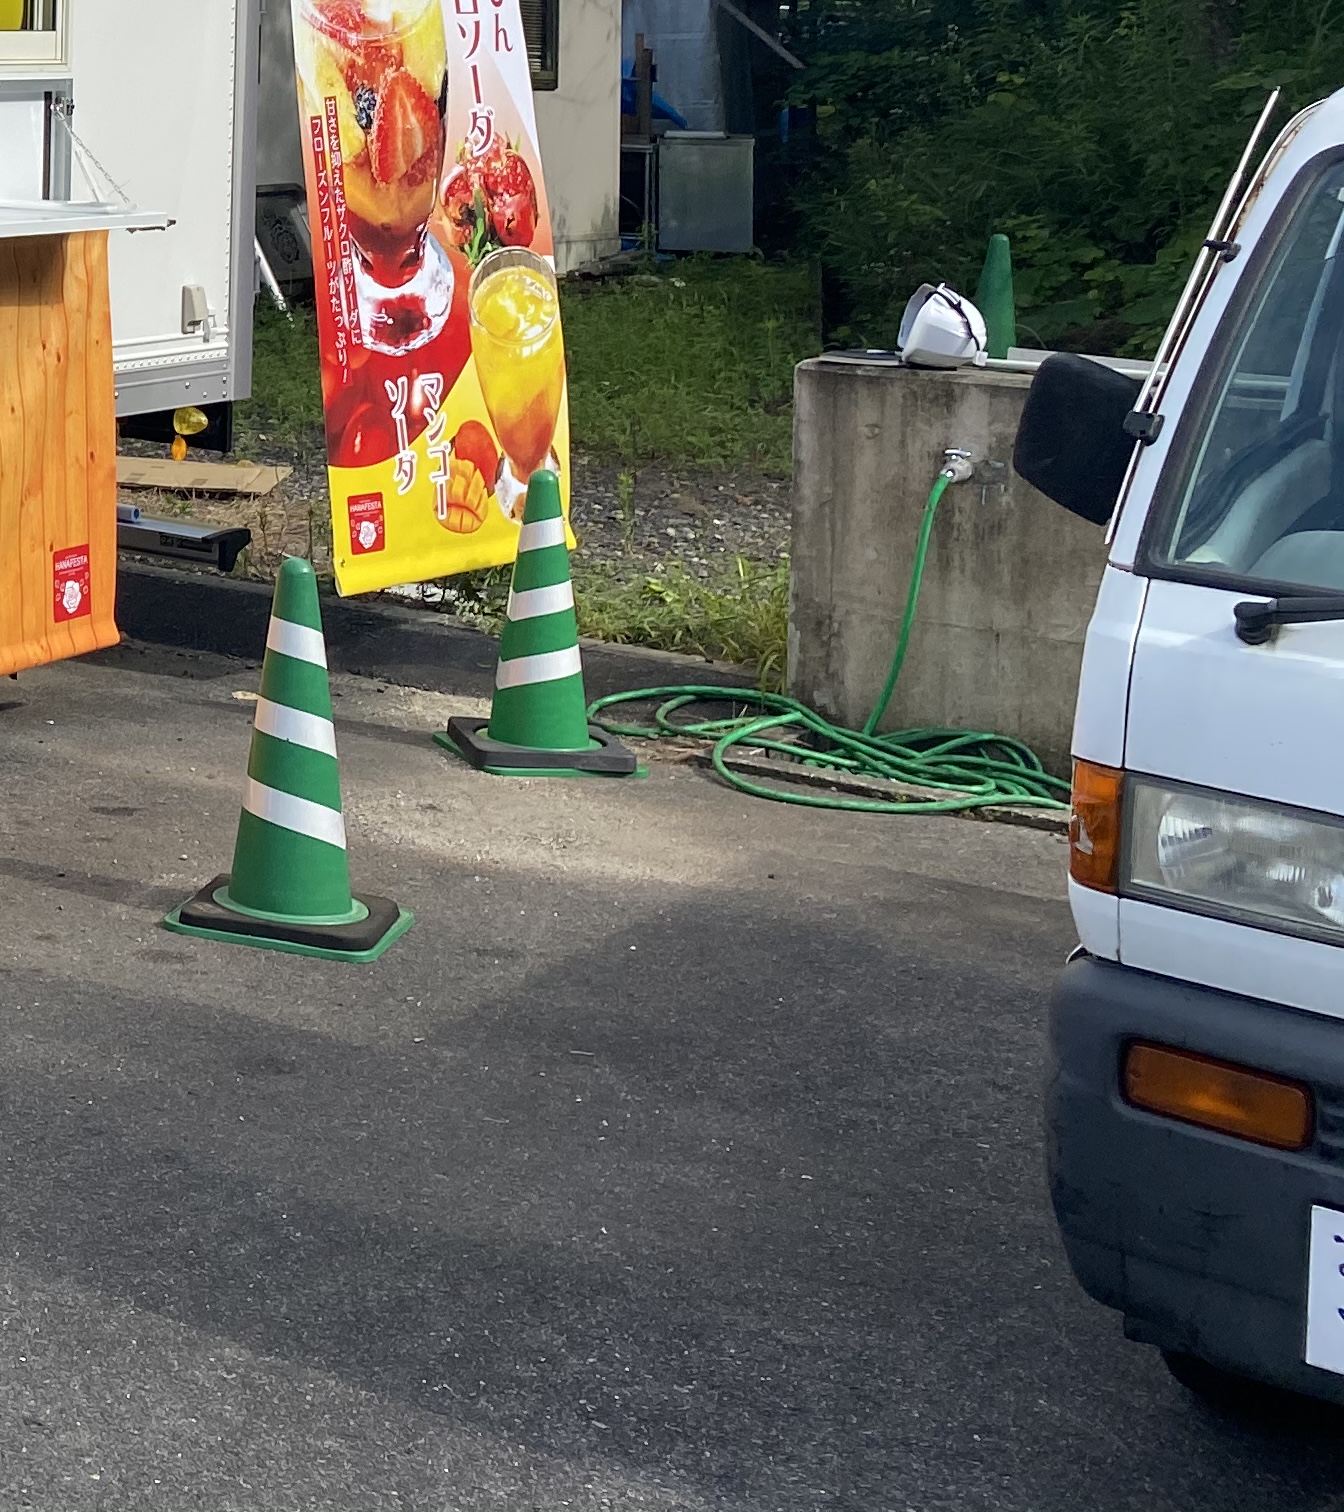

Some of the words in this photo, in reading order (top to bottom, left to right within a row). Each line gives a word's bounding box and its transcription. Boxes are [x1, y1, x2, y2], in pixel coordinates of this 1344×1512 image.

[387, 379, 416, 493] ソーダ
[419, 375, 449, 517] マンゴー
